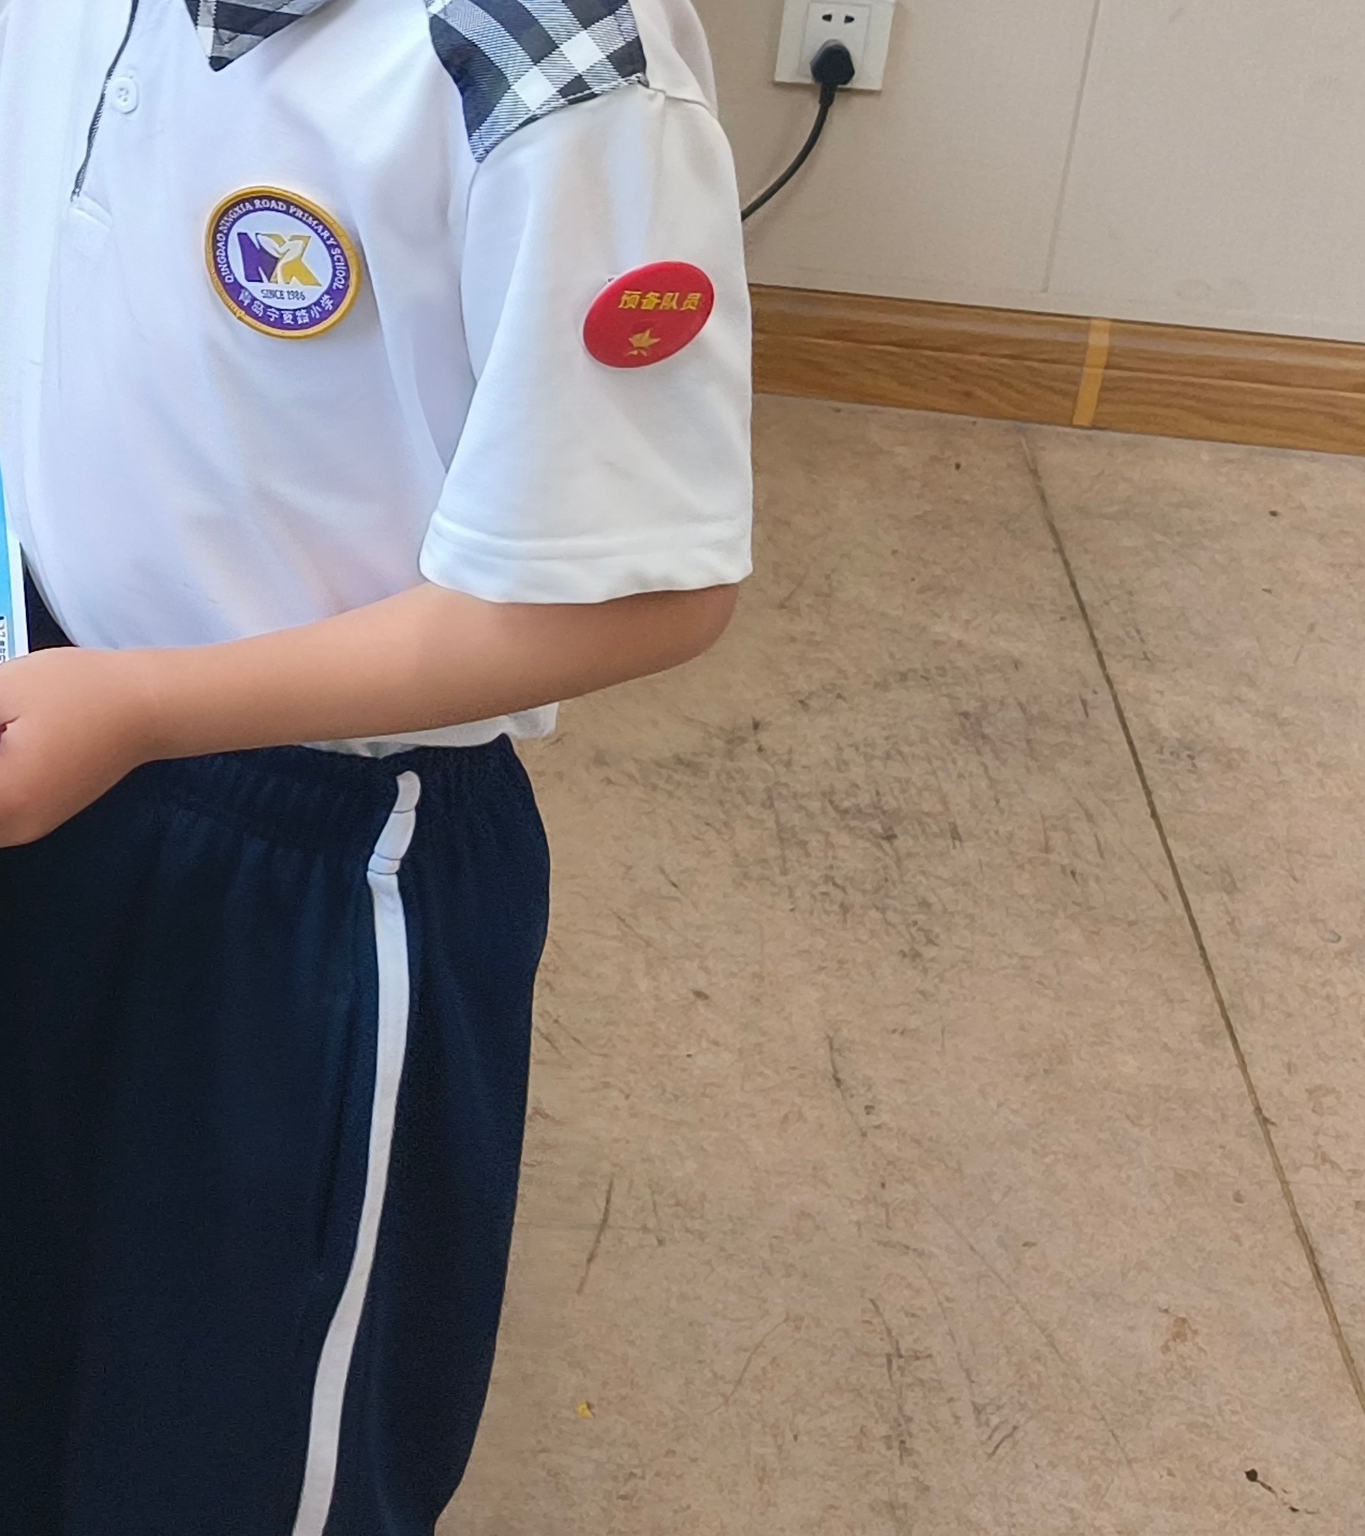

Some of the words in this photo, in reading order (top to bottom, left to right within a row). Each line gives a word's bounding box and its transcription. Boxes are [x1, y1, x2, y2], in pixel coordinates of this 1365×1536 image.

[216, 234, 235, 284] QINGDAO
[254, 199, 287, 211] ROAD
[289, 205, 336, 245] PRIMARY
[331, 247, 347, 290] SCHOOL
[238, 288, 334, 325] 青岛宁夏路小学
[261, 289, 285, 300] SINCE
[618, 290, 702, 311] 预备队员
